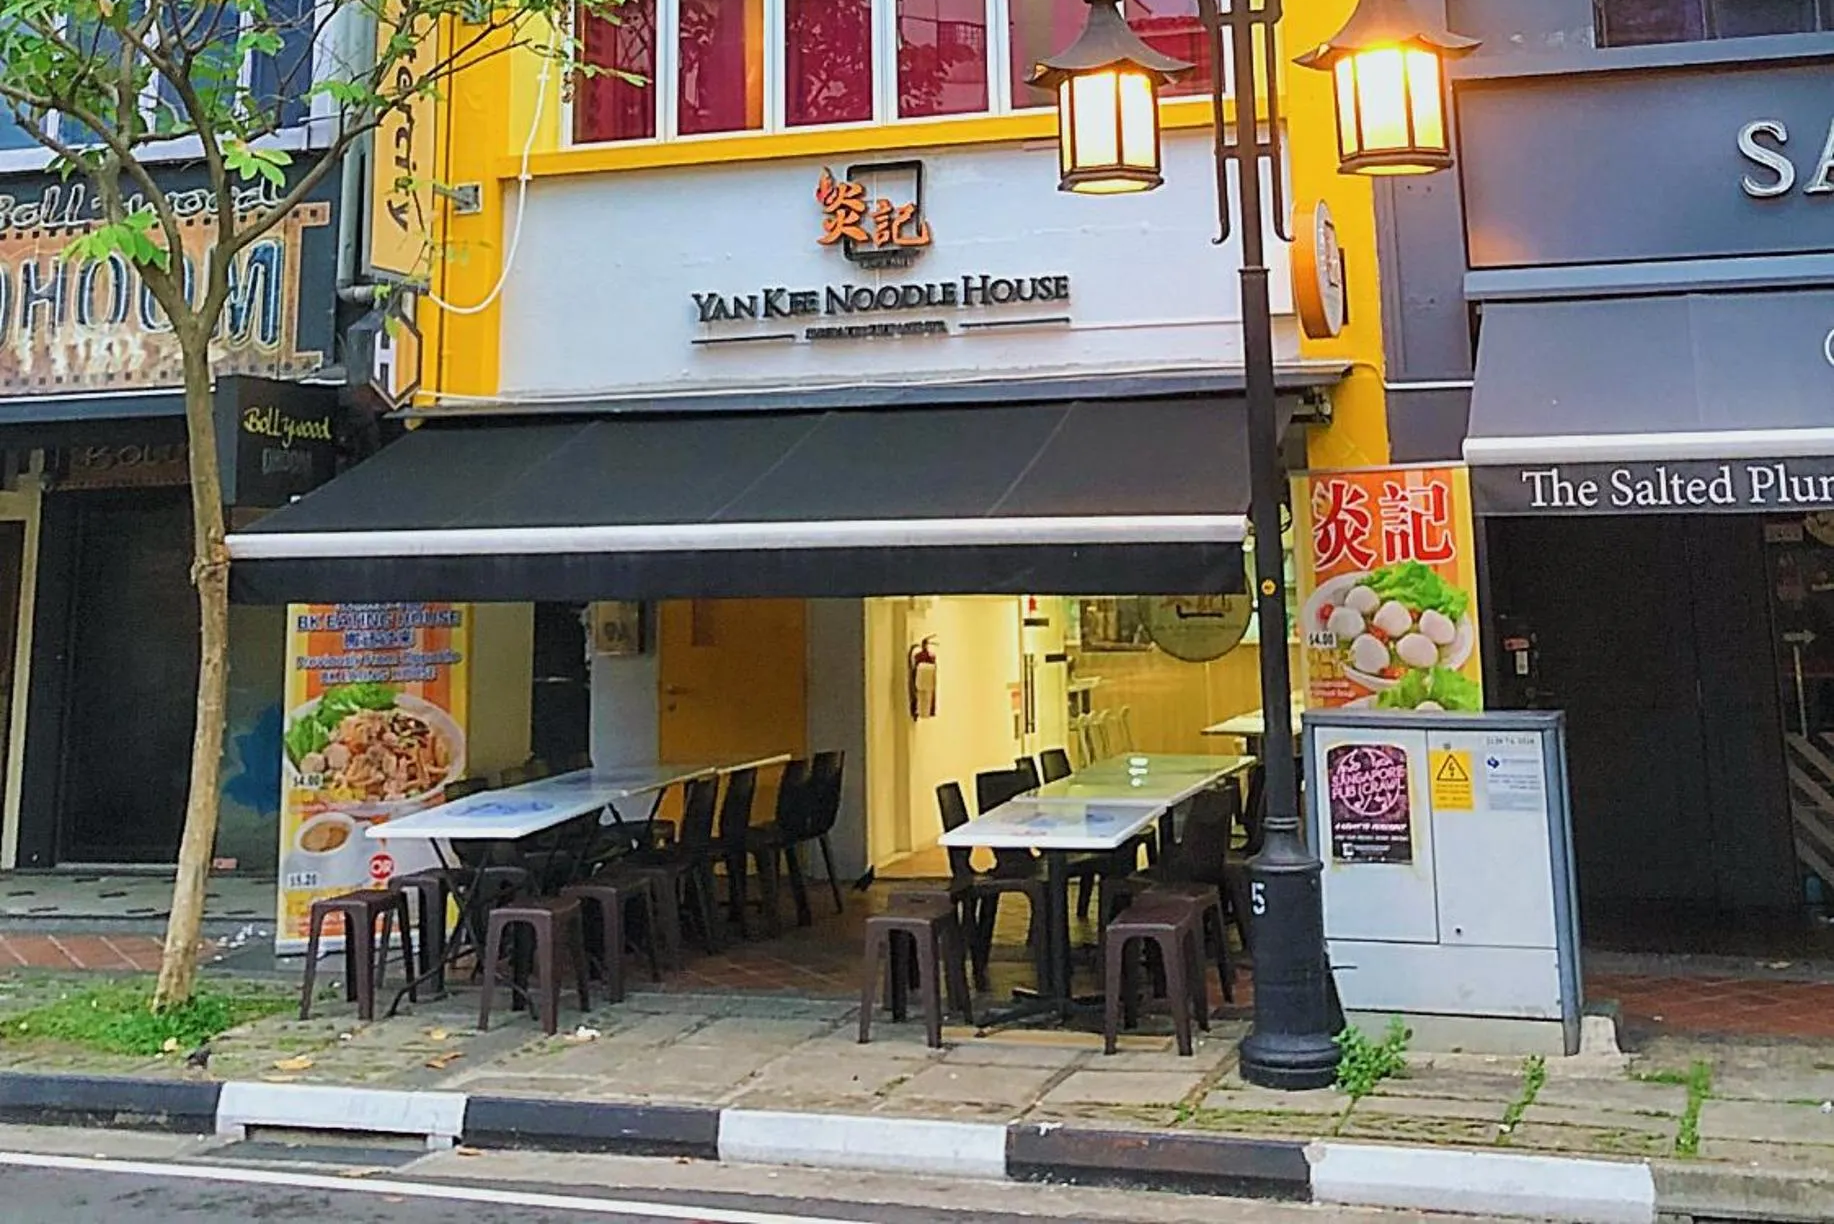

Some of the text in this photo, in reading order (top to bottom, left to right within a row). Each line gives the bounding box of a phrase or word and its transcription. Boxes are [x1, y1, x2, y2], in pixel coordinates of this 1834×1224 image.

[691, 275, 1069, 322] YAN KEE NOODLE HOUSE
[243, 408, 332, 448] Bollywood
[1521, 467, 1599, 508] The
[1610, 464, 1737, 507] Salted
[1313, 479, 1455, 570] 炎記
[370, 858, 393, 874] OR
[1251, 882, 1266, 915] 5
